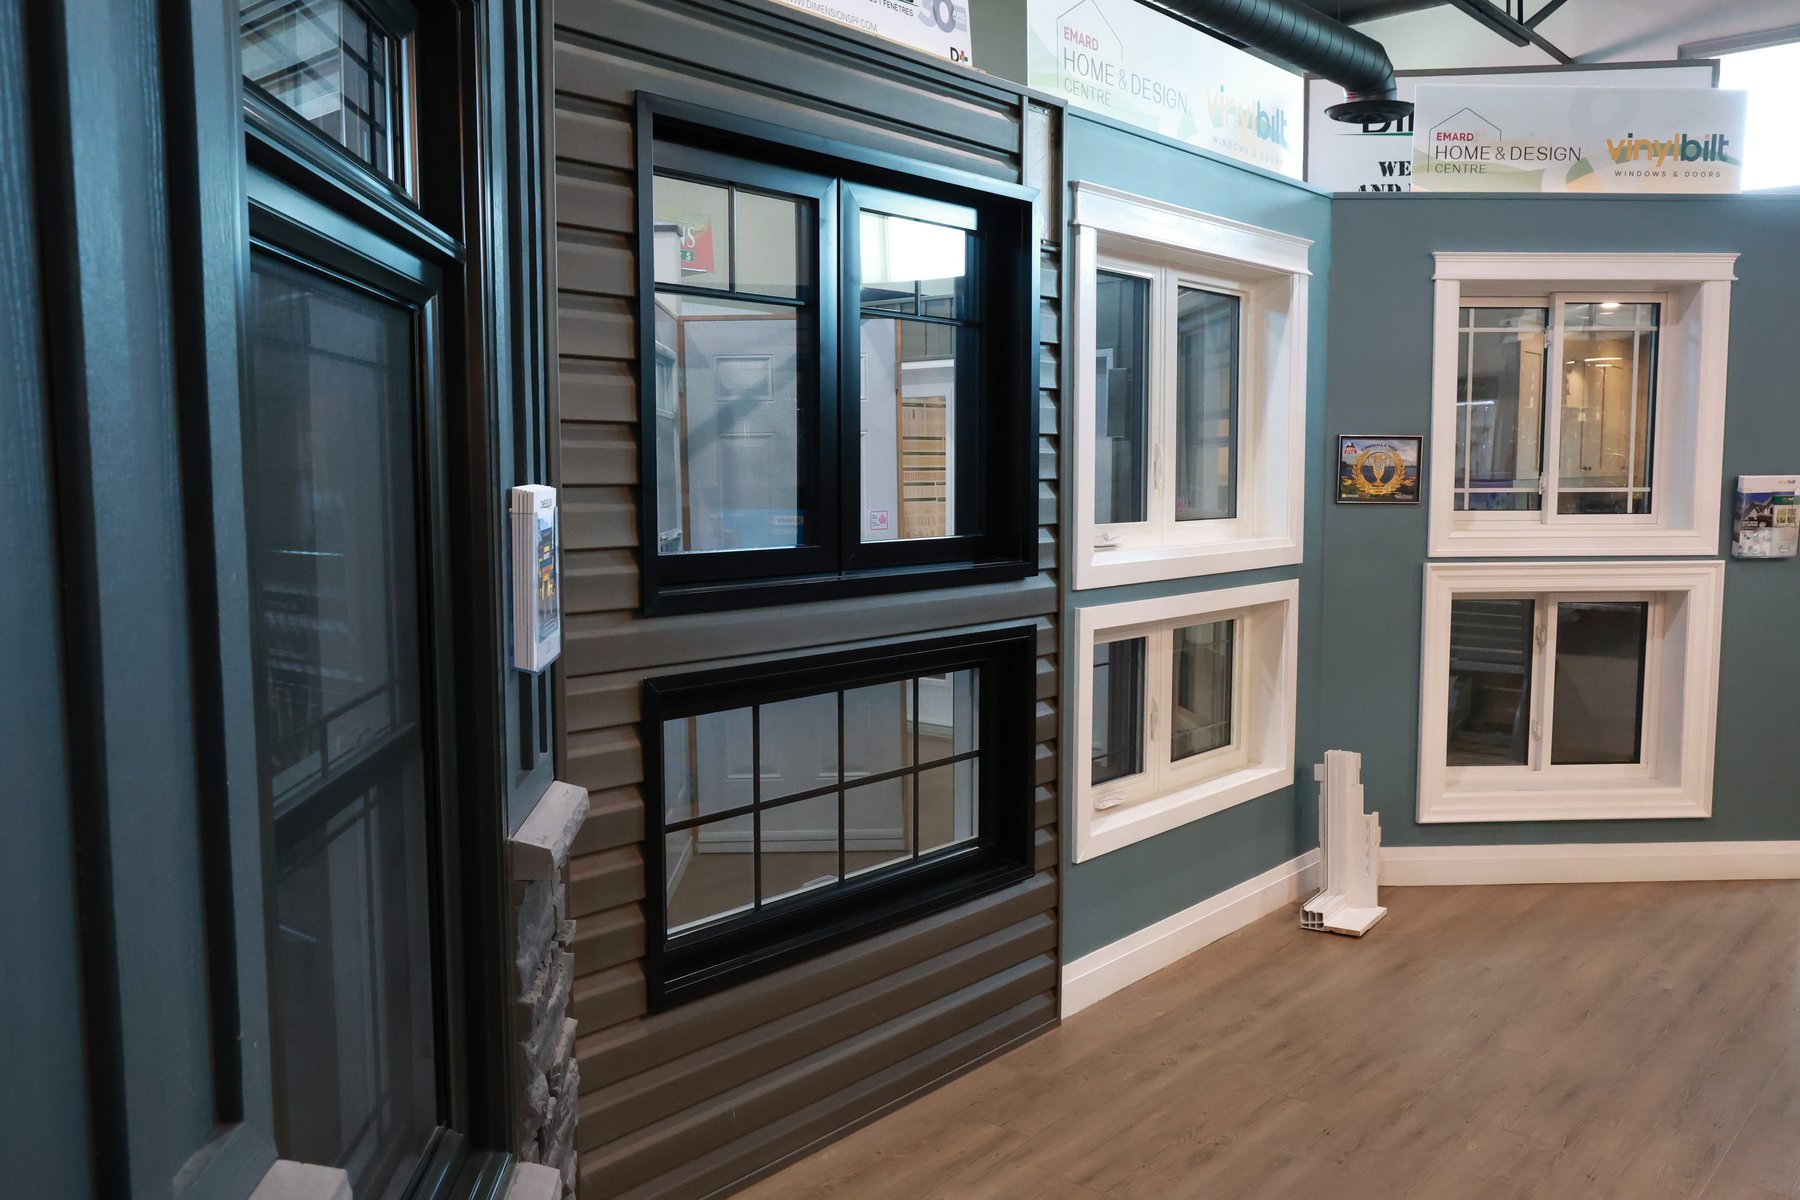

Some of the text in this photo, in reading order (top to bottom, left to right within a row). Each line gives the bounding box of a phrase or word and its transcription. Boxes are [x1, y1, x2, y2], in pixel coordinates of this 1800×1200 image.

[1063, 26, 1099, 51] EMARD
[1064, 47, 1188, 114] HOME & DESIGN
[1064, 77, 1112, 107] CENTRE
[1436, 132, 1475, 142] EMARD
[1435, 145, 1582, 162] HOME & DESIGN
[1606, 132, 1730, 168] vinylbilt
[1435, 163, 1487, 174] CENTRE
[1614, 170, 1667, 178] WINDOWS
